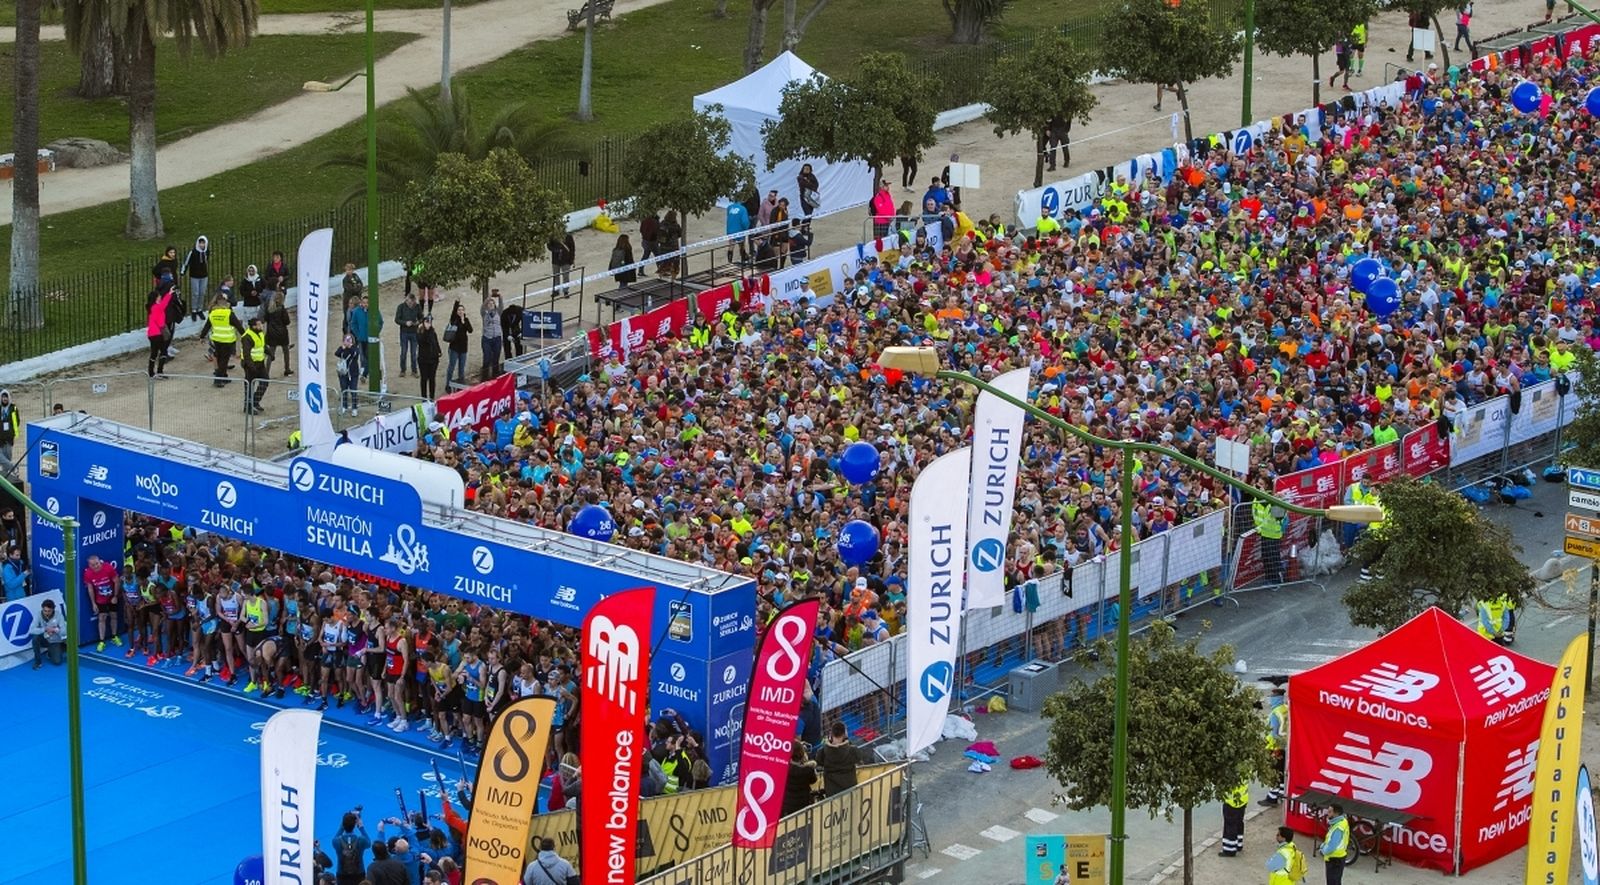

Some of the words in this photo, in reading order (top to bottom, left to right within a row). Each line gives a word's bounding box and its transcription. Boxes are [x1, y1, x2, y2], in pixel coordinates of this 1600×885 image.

[308, 282, 320, 373] ZURICH
[362, 421, 418, 451] ZURIC
[319, 474, 384, 505] ZURICH
[984, 427, 1010, 526] ZURICH
[201, 509, 253, 536] ZURICH
[307, 506, 372, 536] MARATÓN
[82, 528, 117, 546] ZURICH
[307, 526, 373, 558] SEVILLA
[454, 575, 512, 603] ZURICH
[930, 524, 952, 645] ZURICH
[658, 681, 697, 702] ZURICH
[713, 684, 746, 705] ZURICH
[761, 686, 795, 704] IMD
[1319, 690, 1351, 711] new
[1484, 711, 1507, 728] new
[487, 787, 522, 807] IMD
[698, 807, 728, 825] IMD
[279, 782, 300, 885] URICH
[1479, 821, 1506, 843] new
[608, 835, 625, 883] new
[1077, 862, 1089, 878] E
